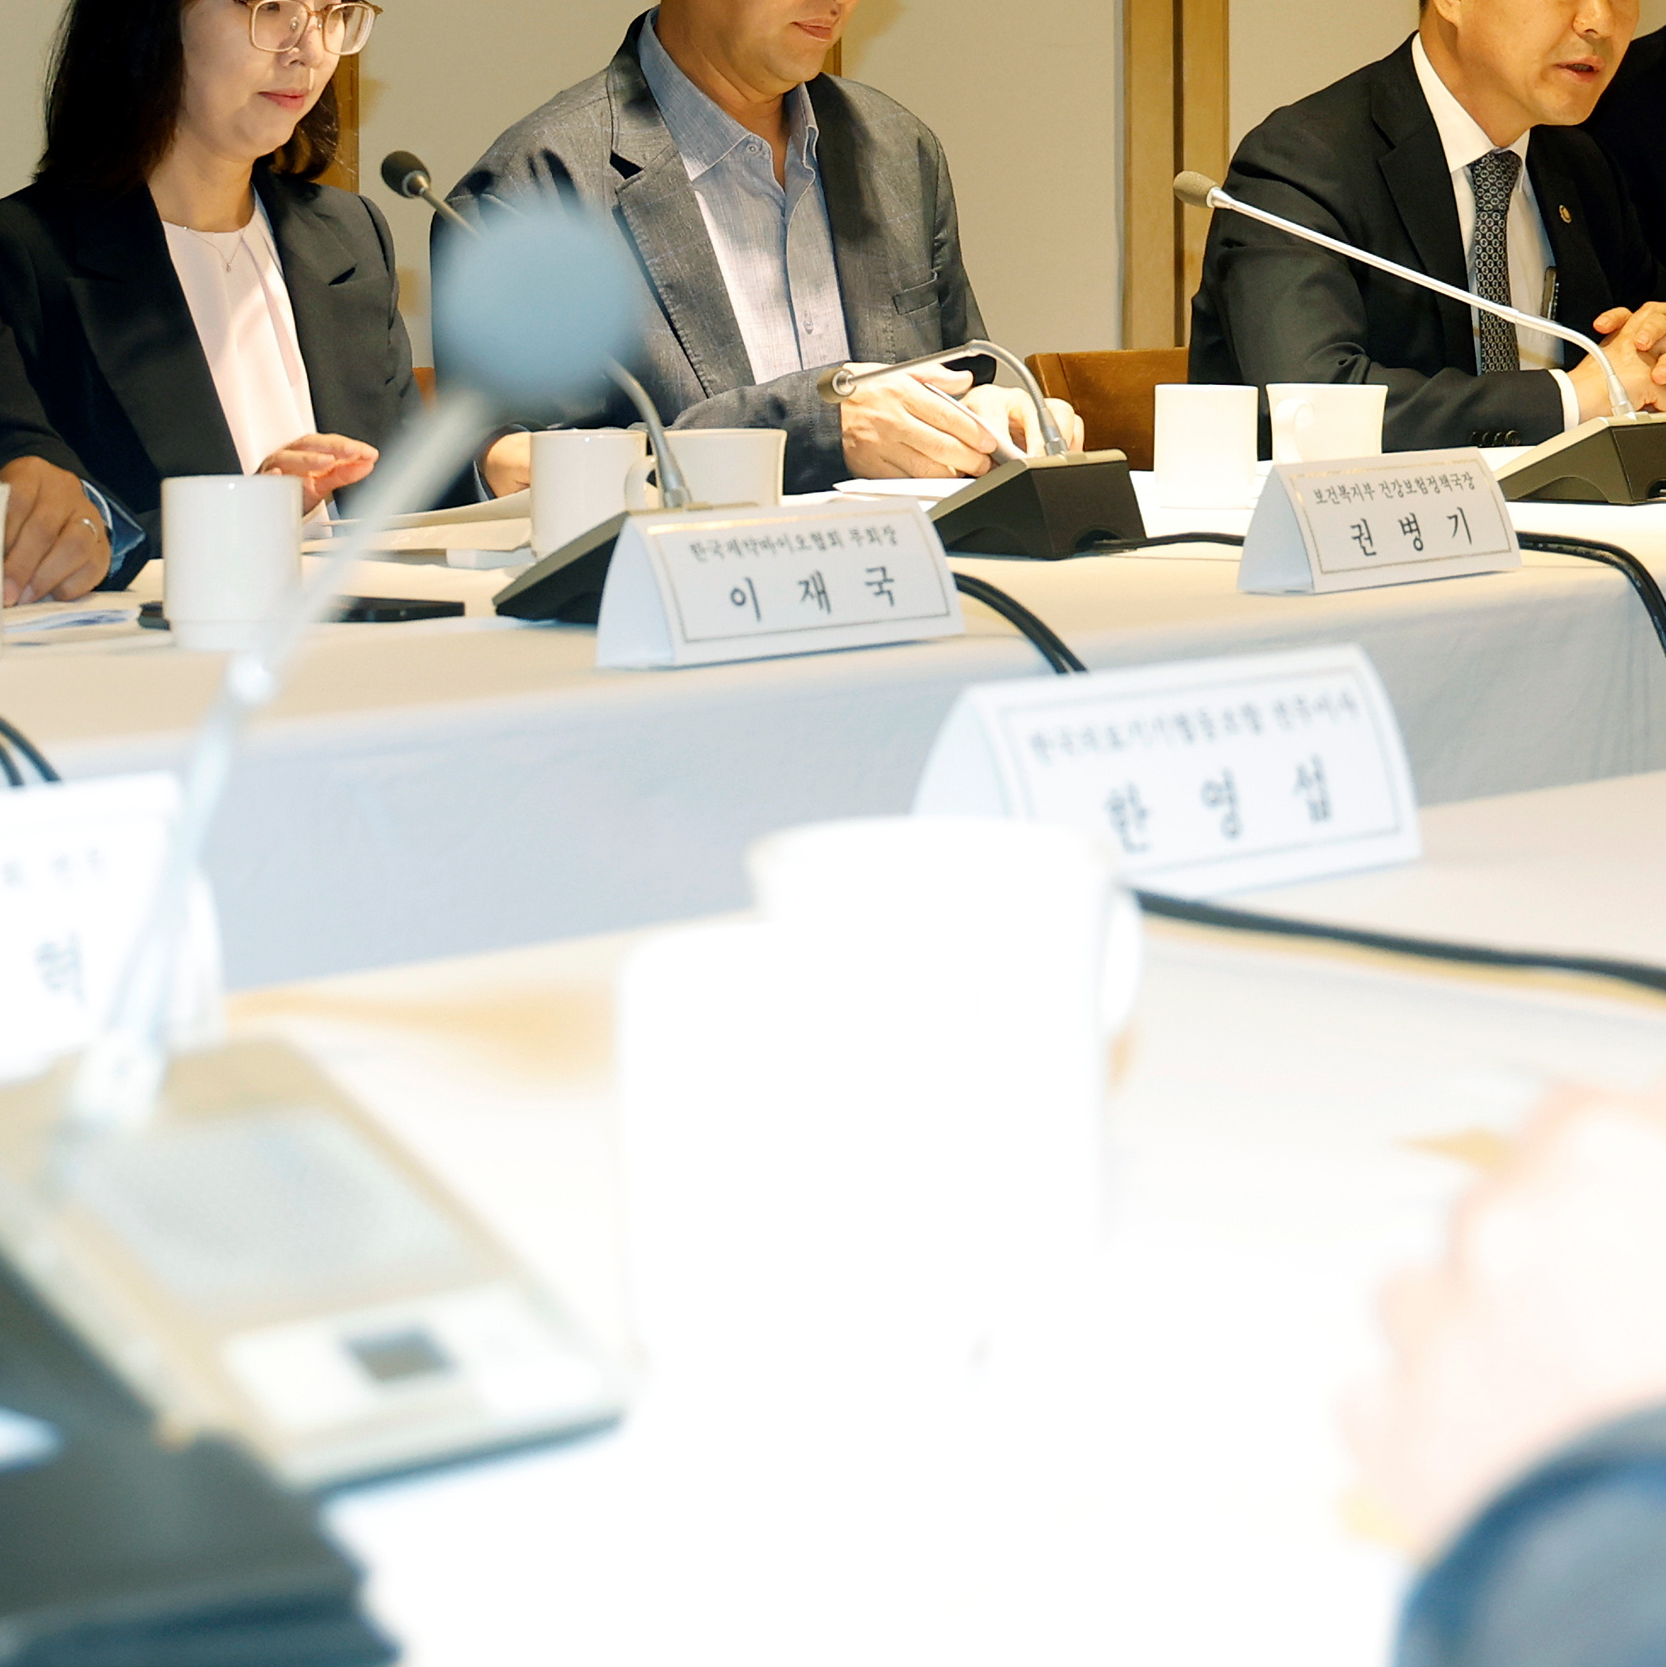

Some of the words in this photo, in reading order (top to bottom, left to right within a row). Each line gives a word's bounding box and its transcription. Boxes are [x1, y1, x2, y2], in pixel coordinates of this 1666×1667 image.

[1313, 481, 1375, 505] 보건복지부
[1378, 471, 1476, 499] 건강보험정책국장
[1350, 506, 1473, 558] 권병기
[729, 565, 895, 623] 이재국
